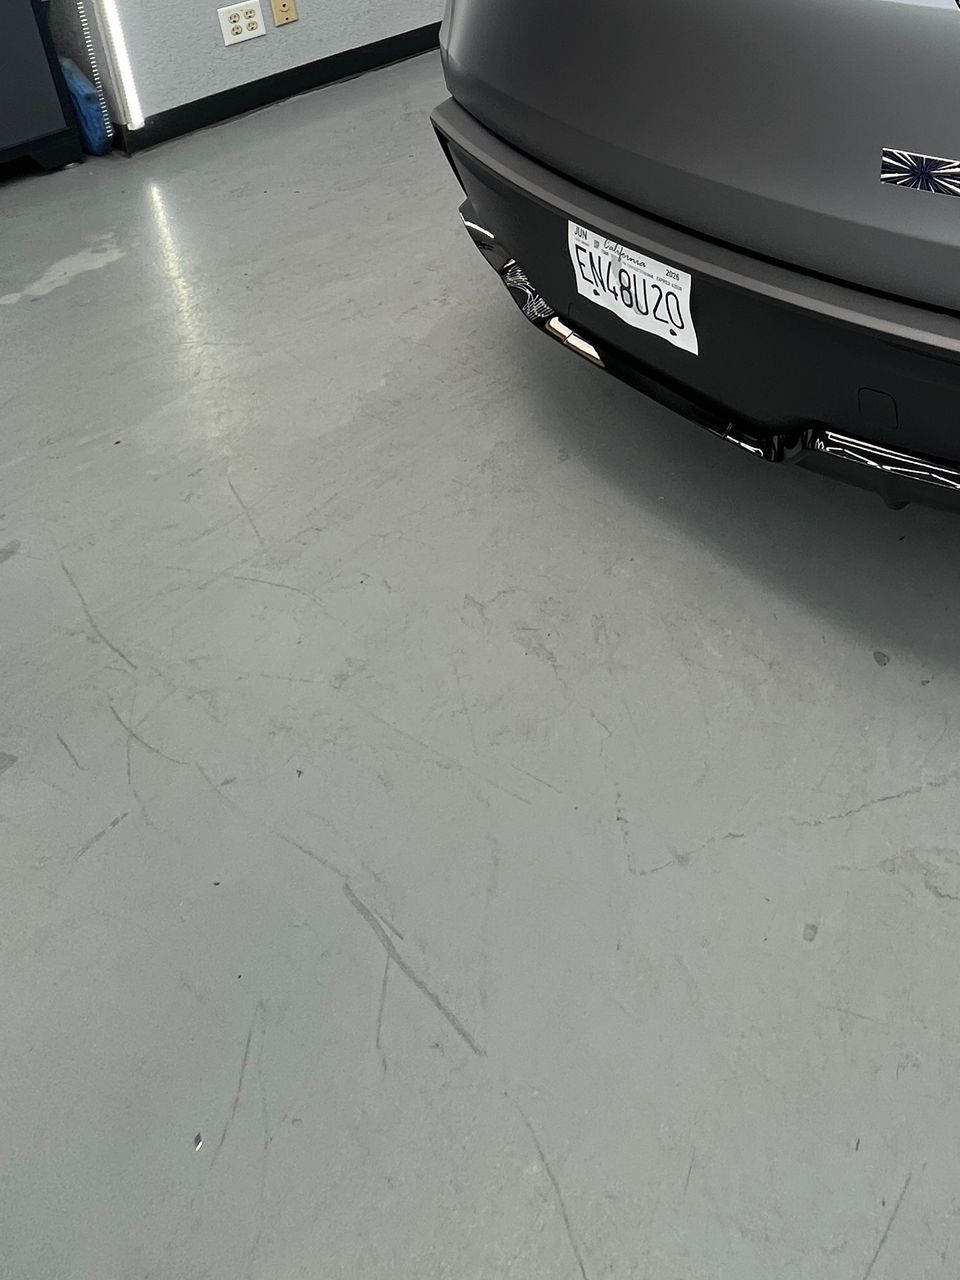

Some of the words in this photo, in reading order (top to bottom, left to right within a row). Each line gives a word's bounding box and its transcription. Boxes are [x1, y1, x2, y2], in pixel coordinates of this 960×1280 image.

[574, 226, 588, 241] JUN
[603, 239, 646, 267] California
[575, 244, 685, 329] EN48U20
